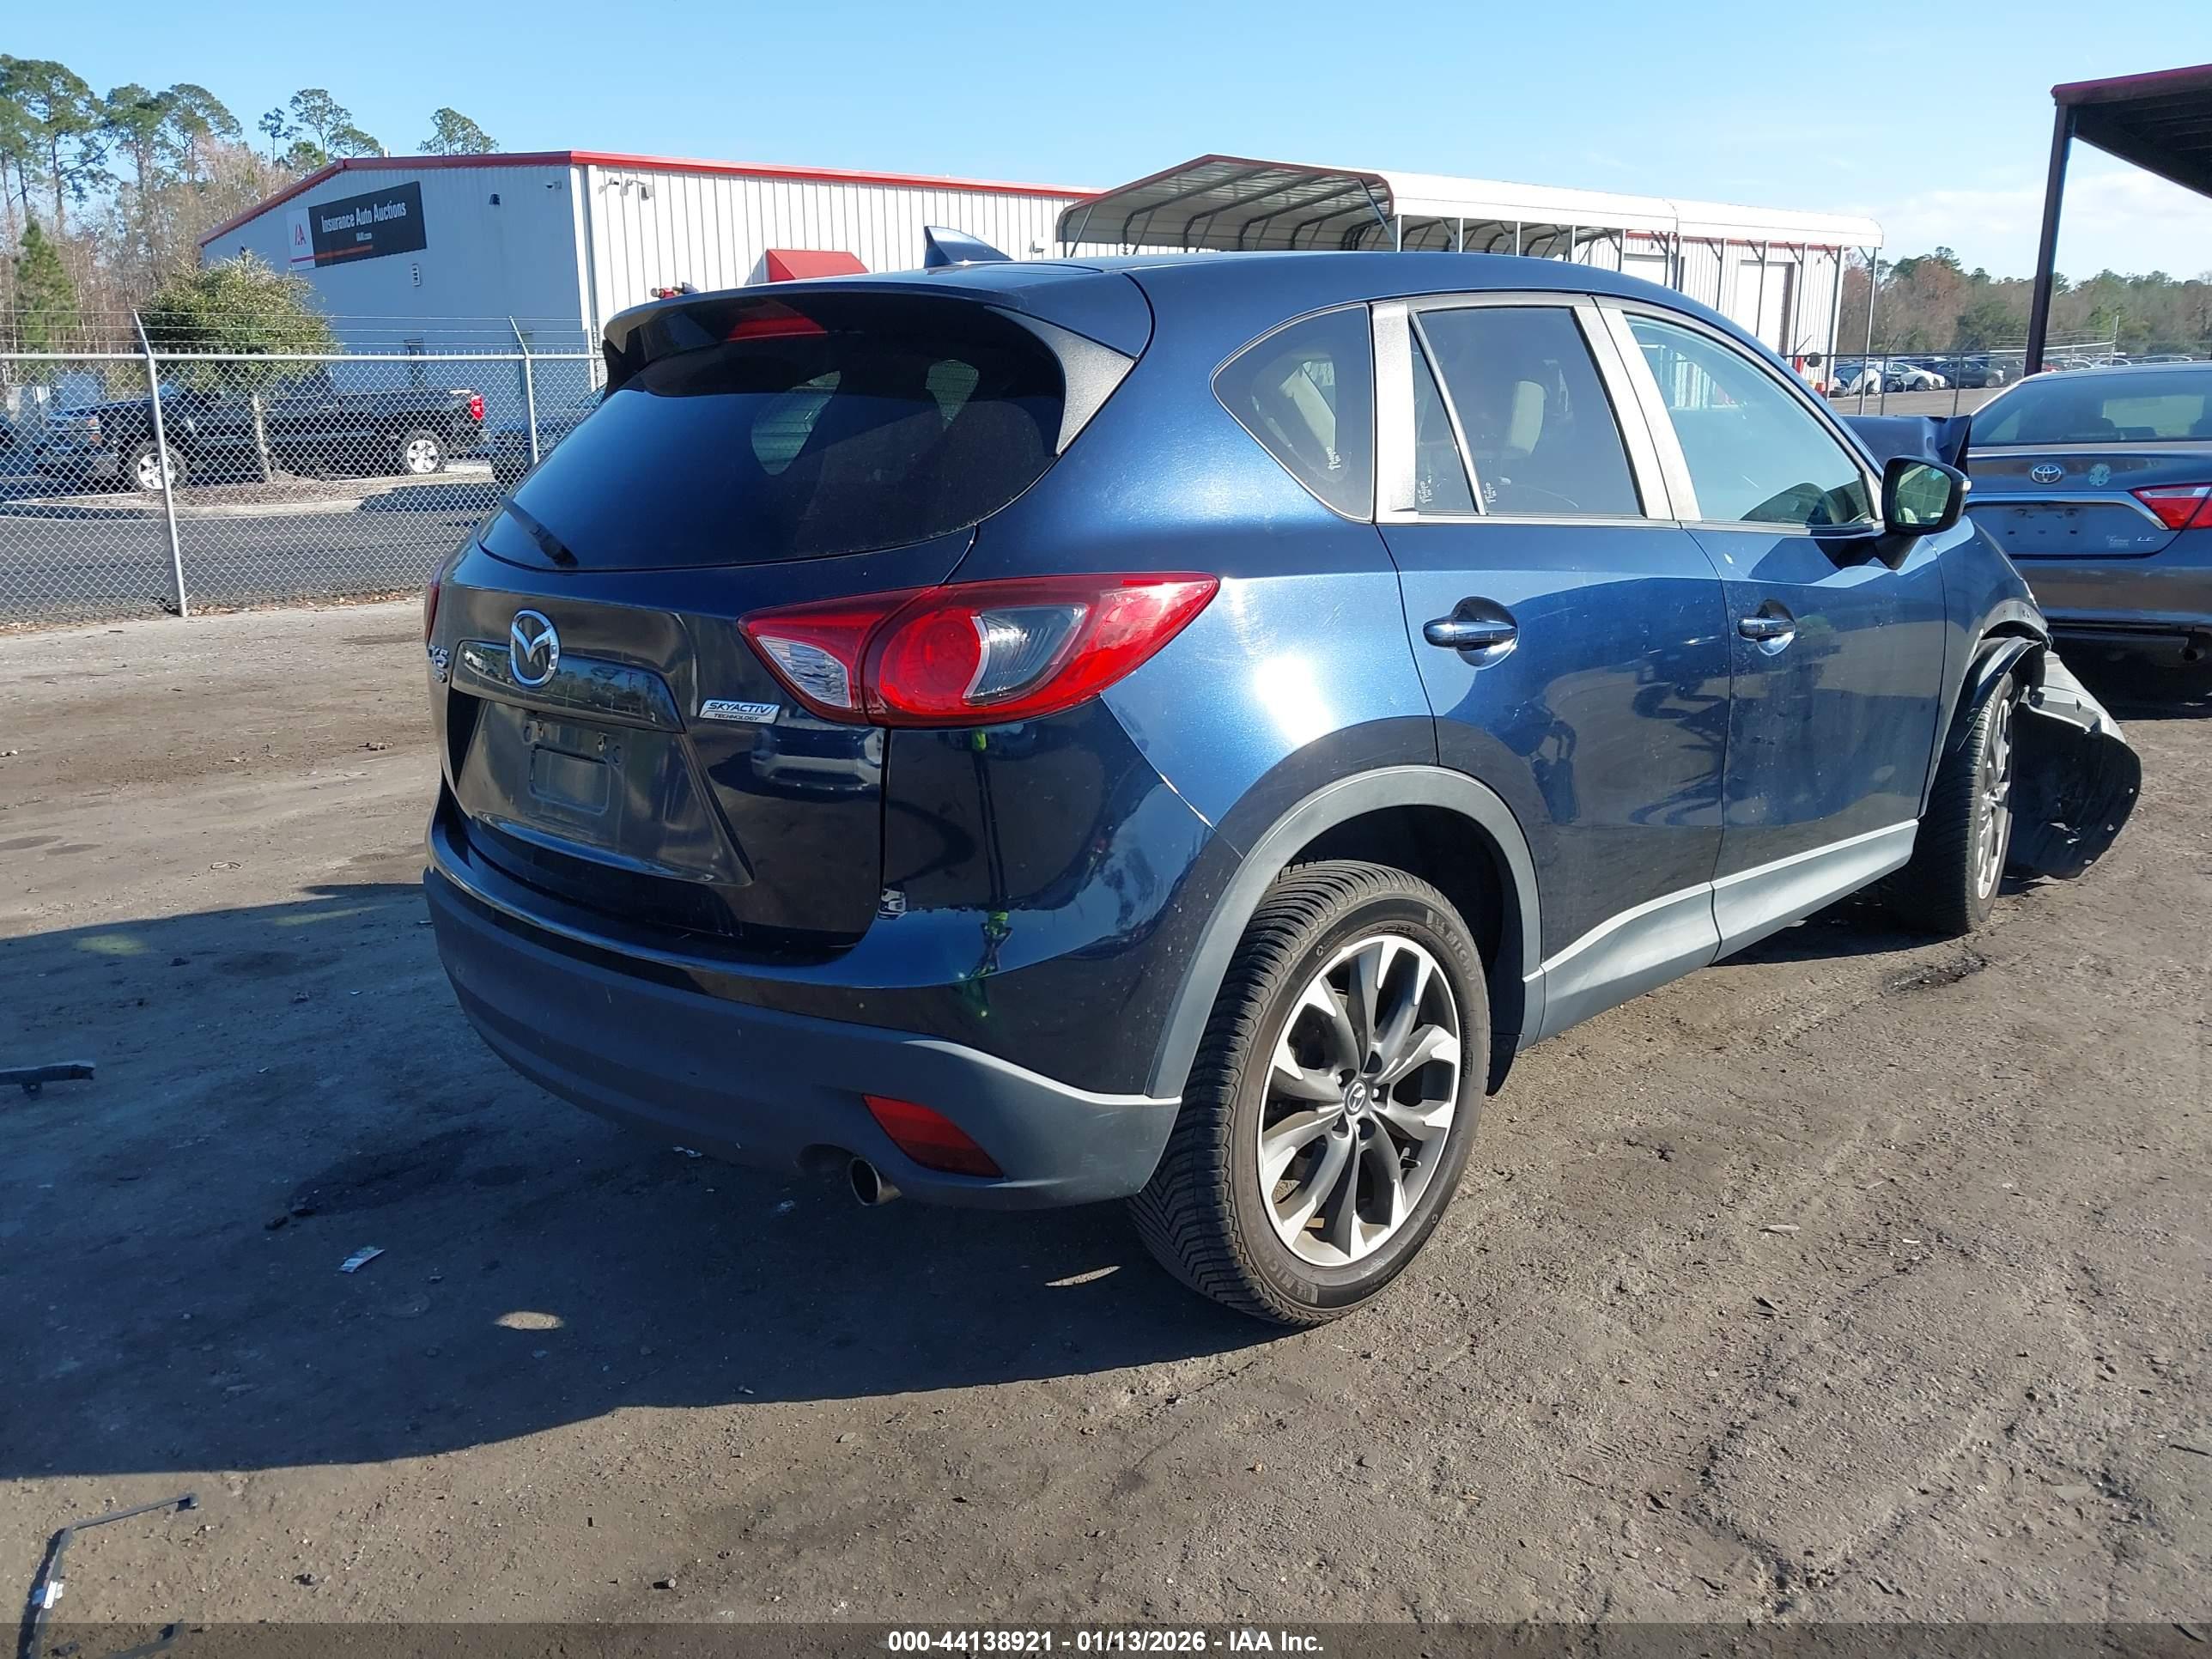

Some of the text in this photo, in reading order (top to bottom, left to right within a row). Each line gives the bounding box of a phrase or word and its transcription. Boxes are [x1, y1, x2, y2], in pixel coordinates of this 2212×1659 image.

[321, 200, 407, 233] Insurance Auto Auctions
[708, 702, 771, 714] SKYACTIV
[714, 713, 761, 721] TECHNOLOGY
